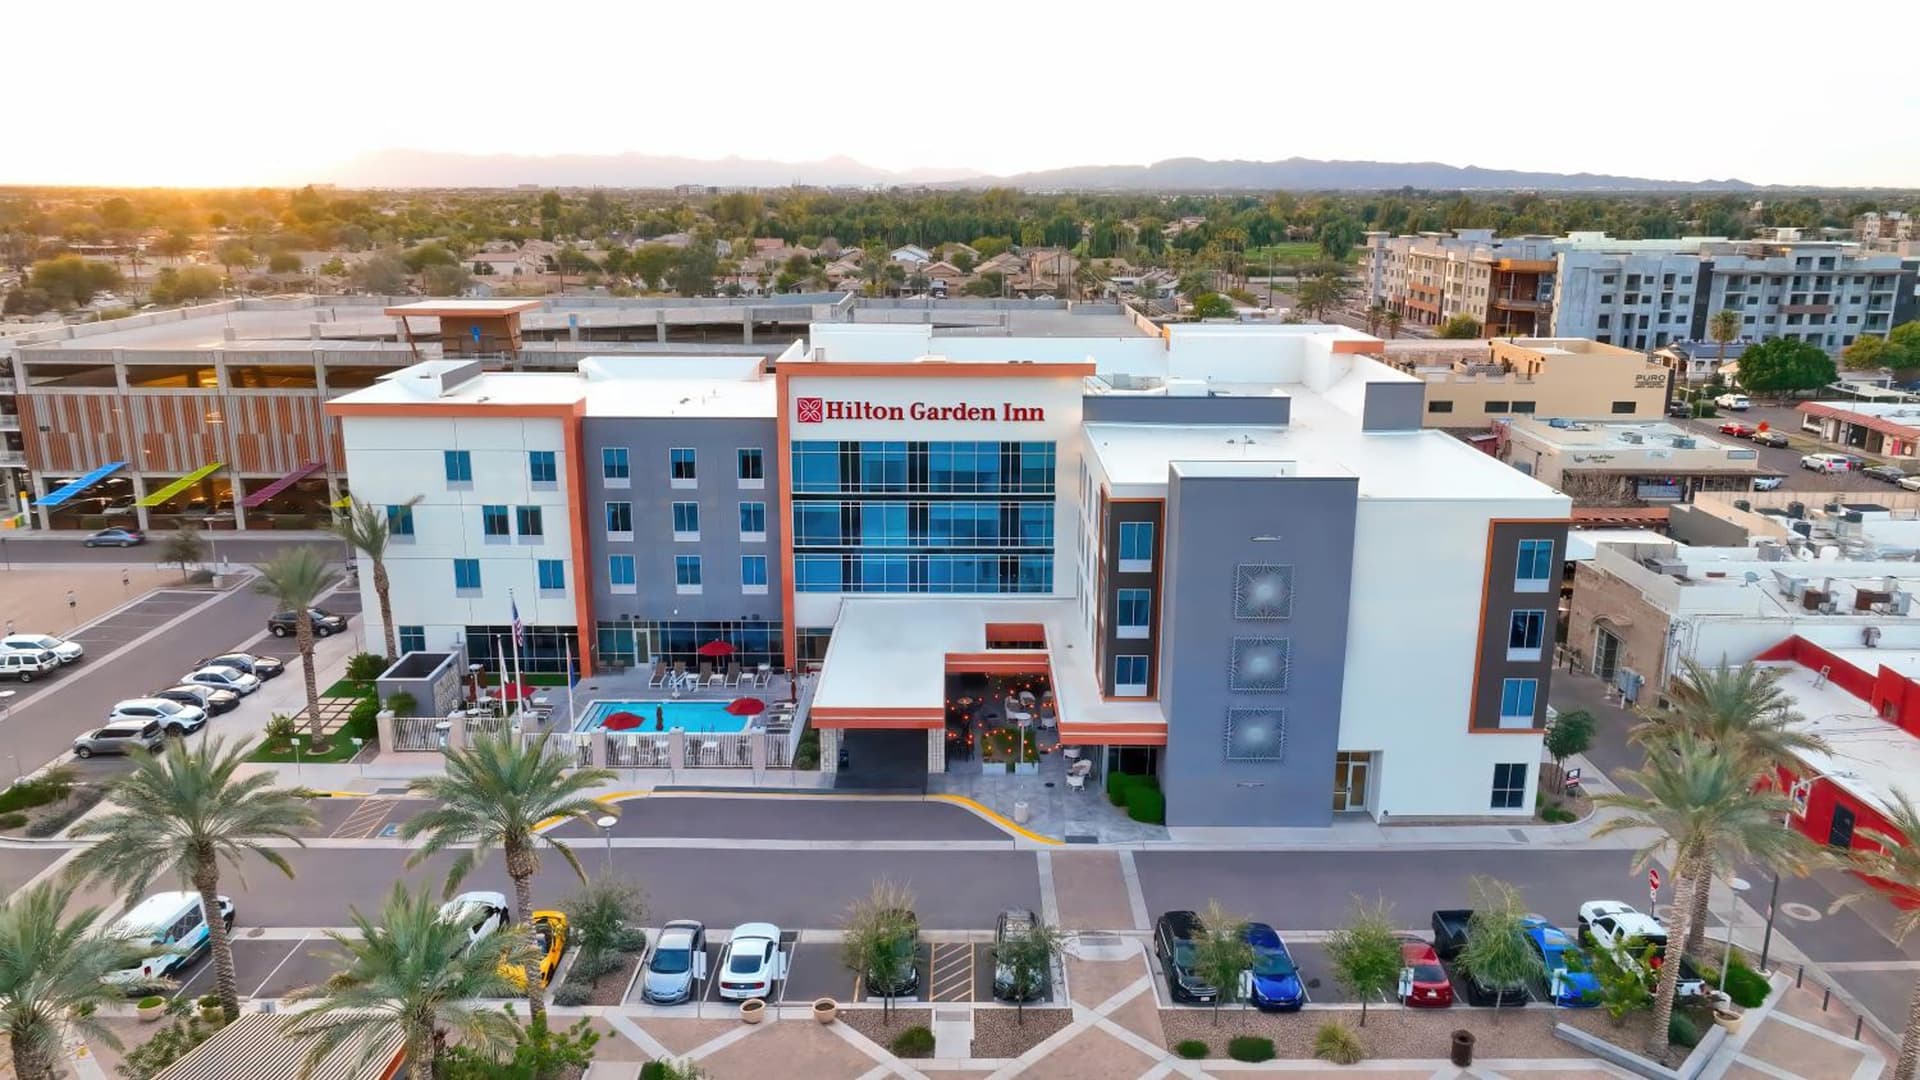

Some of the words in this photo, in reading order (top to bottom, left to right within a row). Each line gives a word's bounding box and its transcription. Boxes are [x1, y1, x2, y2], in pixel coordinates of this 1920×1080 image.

[825, 401, 904, 420] Hilton
[909, 402, 996, 421] Garden
[1003, 403, 1045, 422] Inn
